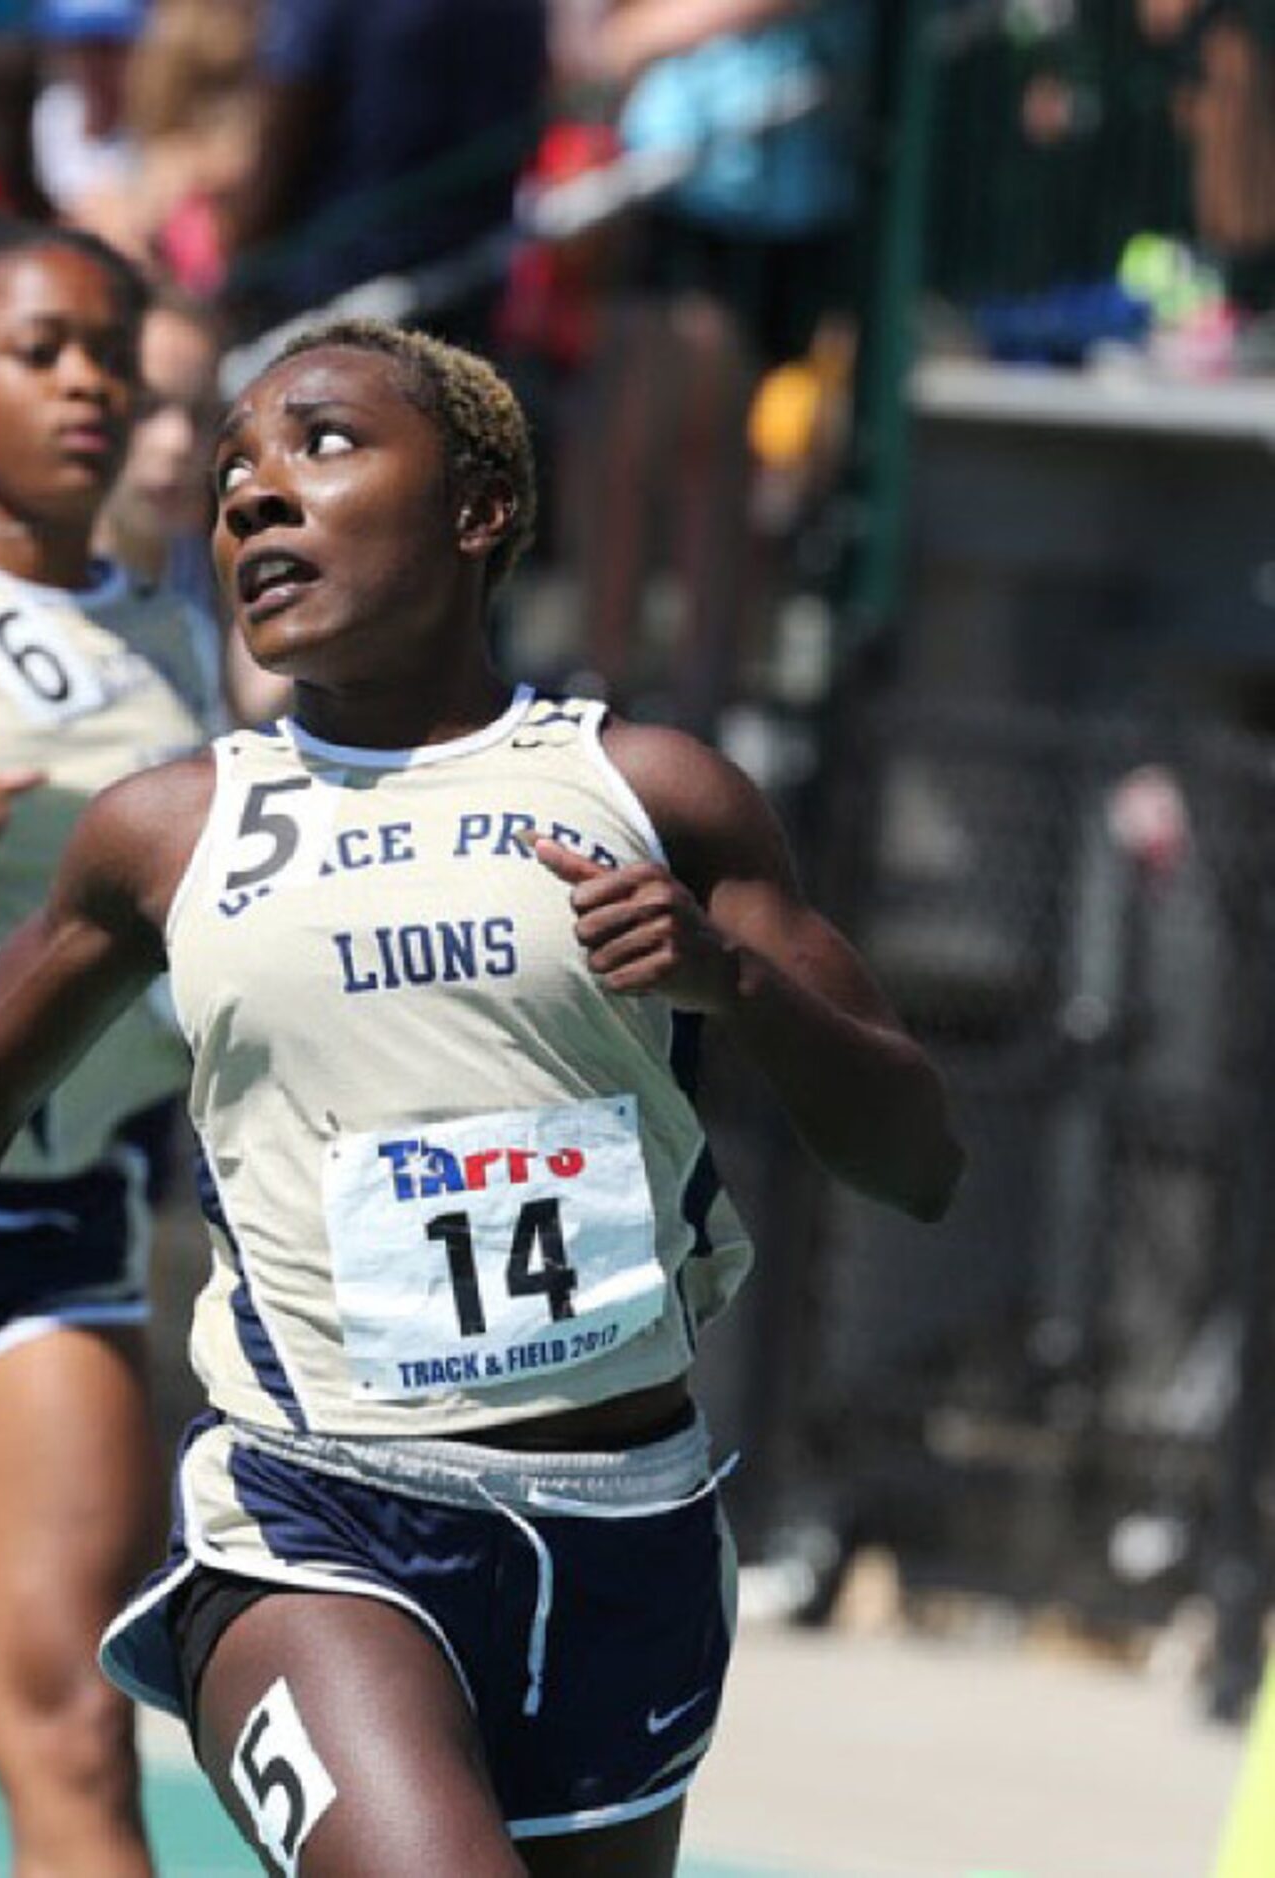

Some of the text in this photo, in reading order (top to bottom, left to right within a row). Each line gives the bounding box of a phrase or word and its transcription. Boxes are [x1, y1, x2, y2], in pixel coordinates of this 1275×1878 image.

[225, 777, 312, 890] 5
[334, 916, 518, 994] LIONS
[426, 1196, 579, 1338] 14
[398, 1324, 621, 1389] TRACK & FIELD 2017
[238, 1703, 306, 1859] 5
